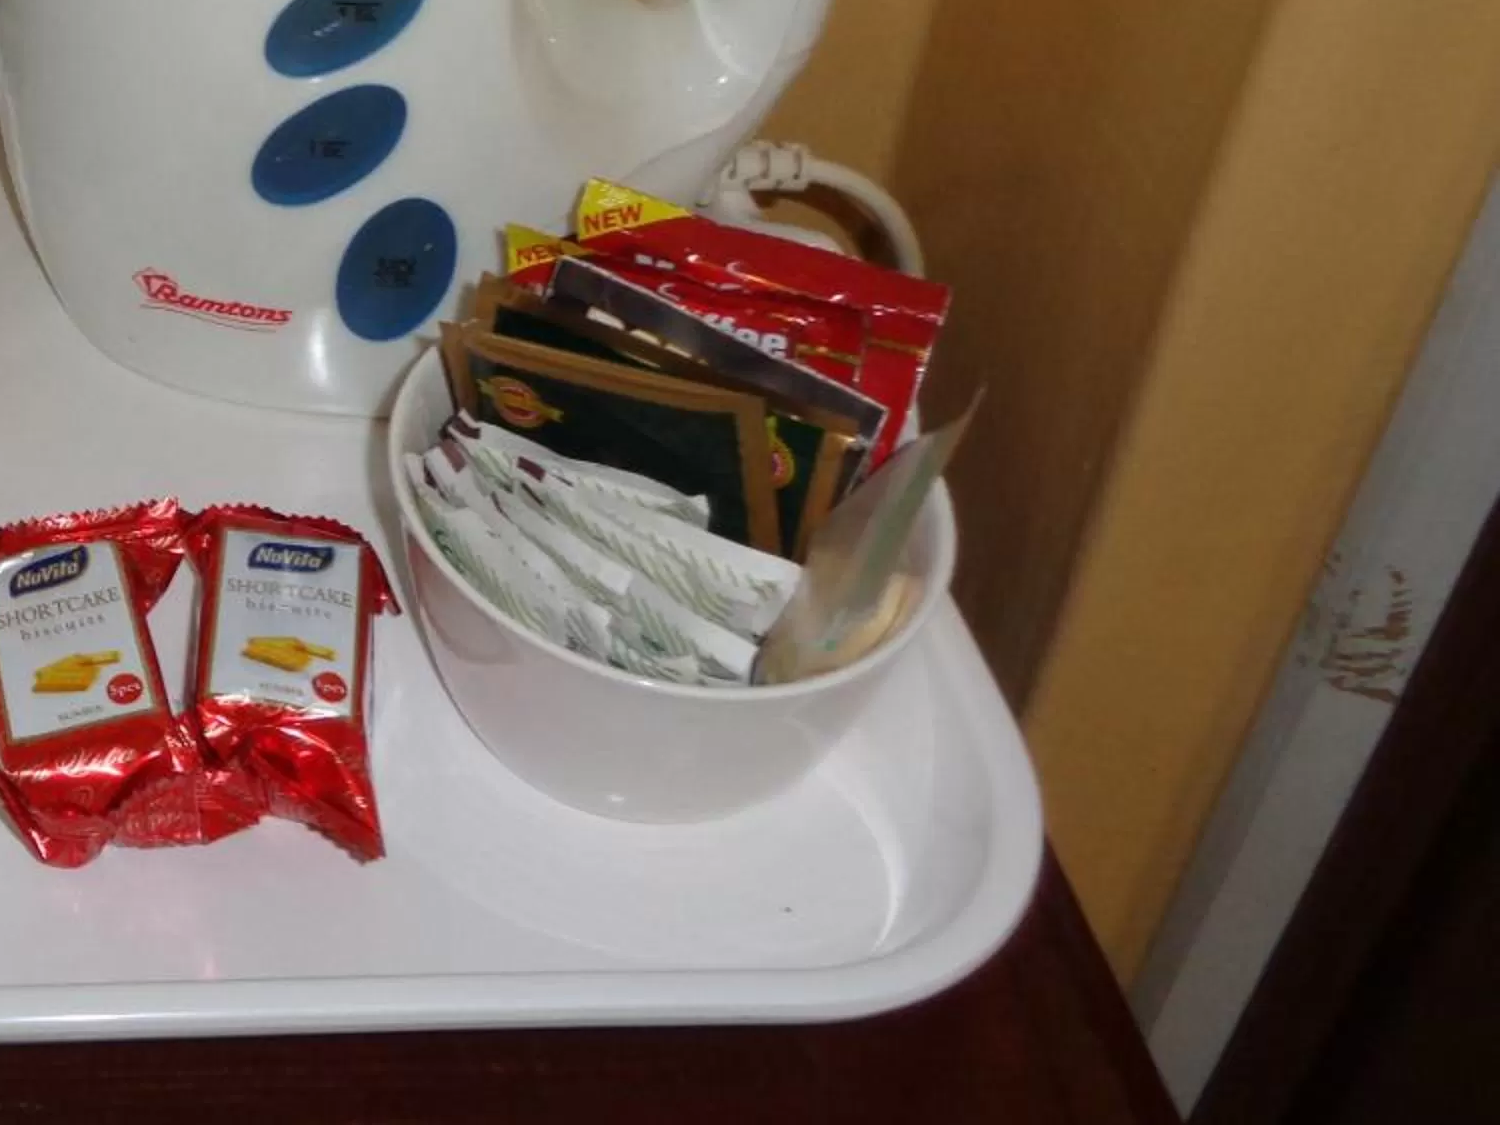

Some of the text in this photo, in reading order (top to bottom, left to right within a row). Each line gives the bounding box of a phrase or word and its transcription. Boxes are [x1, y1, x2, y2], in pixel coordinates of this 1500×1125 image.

[583, 203, 643, 231] NEW
[140, 271, 293, 323] Ramtons
[227, 577, 356, 608] SHORTCAKE
